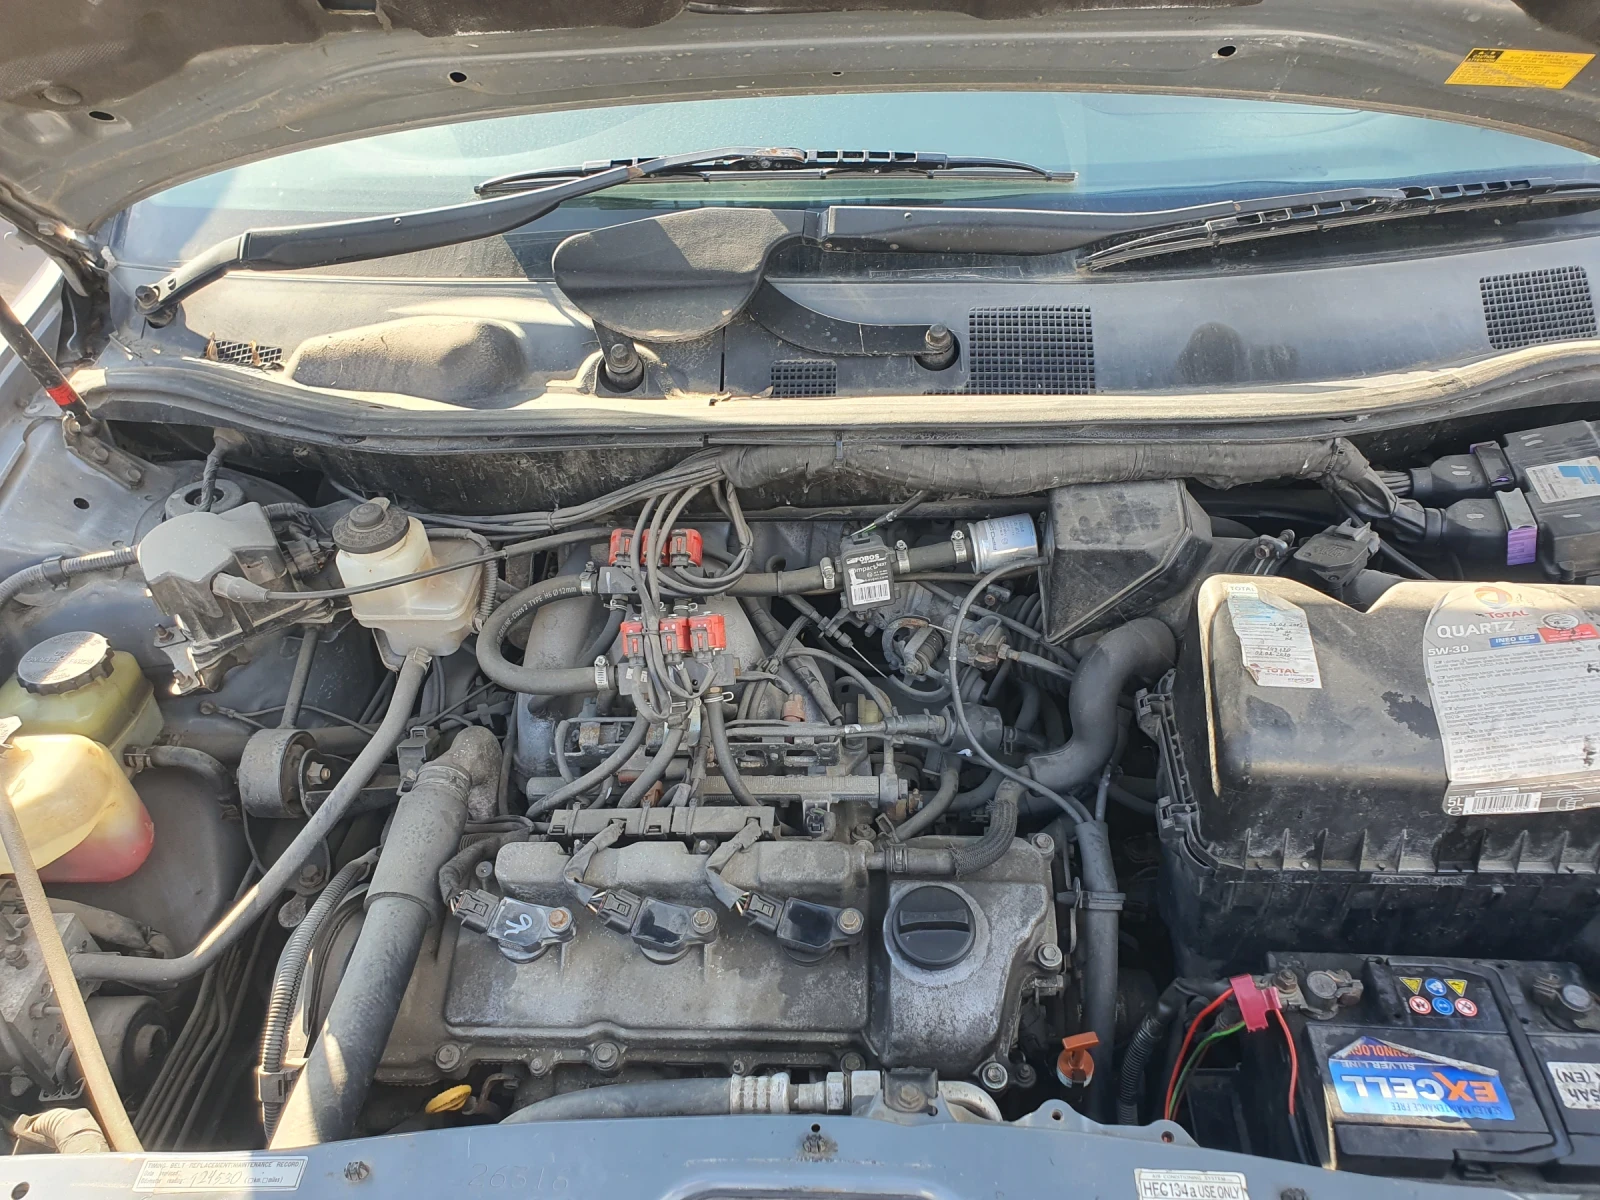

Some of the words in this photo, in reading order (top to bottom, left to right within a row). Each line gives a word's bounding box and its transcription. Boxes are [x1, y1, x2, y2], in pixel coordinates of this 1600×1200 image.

[528, 595, 543, 607] TYPE
[1484, 609, 1530, 620] TOTAL
[1436, 620, 1516, 639] QUARTZ
[1427, 645, 1469, 656] 5W-30
[1266, 666, 1299, 674] TOTAL
[1447, 797, 1464, 807] 5L
[1340, 1060, 1369, 1069] LINE
[1371, 1060, 1416, 1071] SILVER
[1341, 1071, 1500, 1102] EXCELL
[1390, 1102, 1411, 1112] FREE
[1411, 1103, 1471, 1115] MAINTENANCE
[1473, 1105, 1503, 1116] SEALED
[1199, 1185, 1216, 1199] USE
[1217, 1187, 1241, 1200] ONLY
